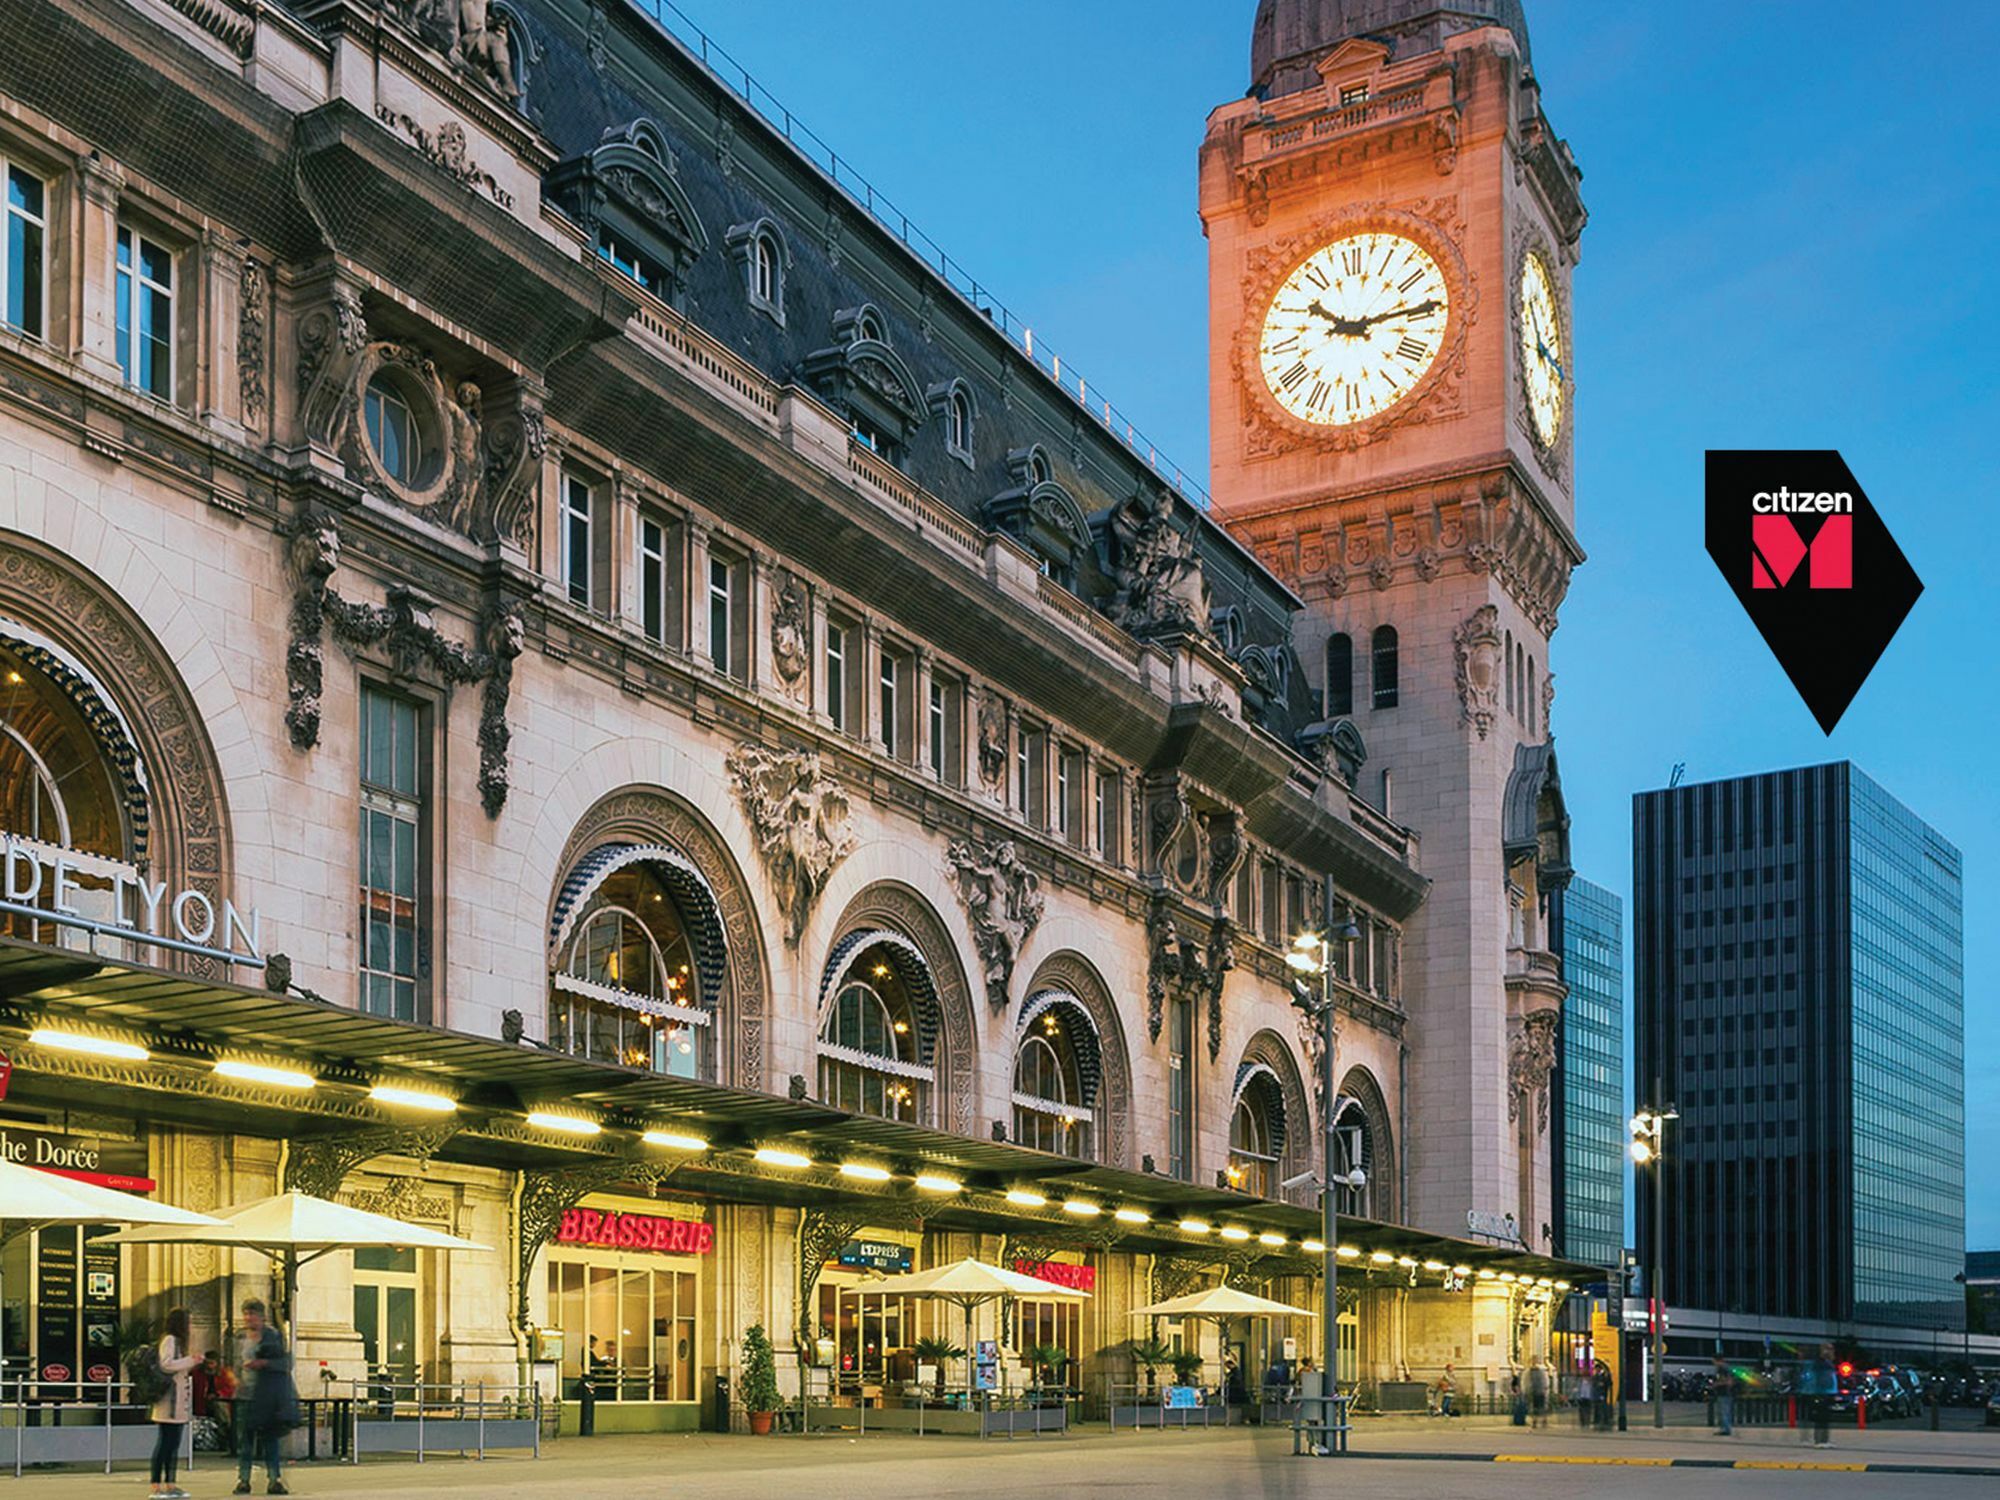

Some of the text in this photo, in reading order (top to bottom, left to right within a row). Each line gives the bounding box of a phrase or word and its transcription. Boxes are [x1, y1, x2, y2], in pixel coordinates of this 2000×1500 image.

[5, 845, 260, 959] DE LYON
[0, 1131, 99, 1170] he Dorée
[558, 1209, 713, 1254] BRASSERIE
